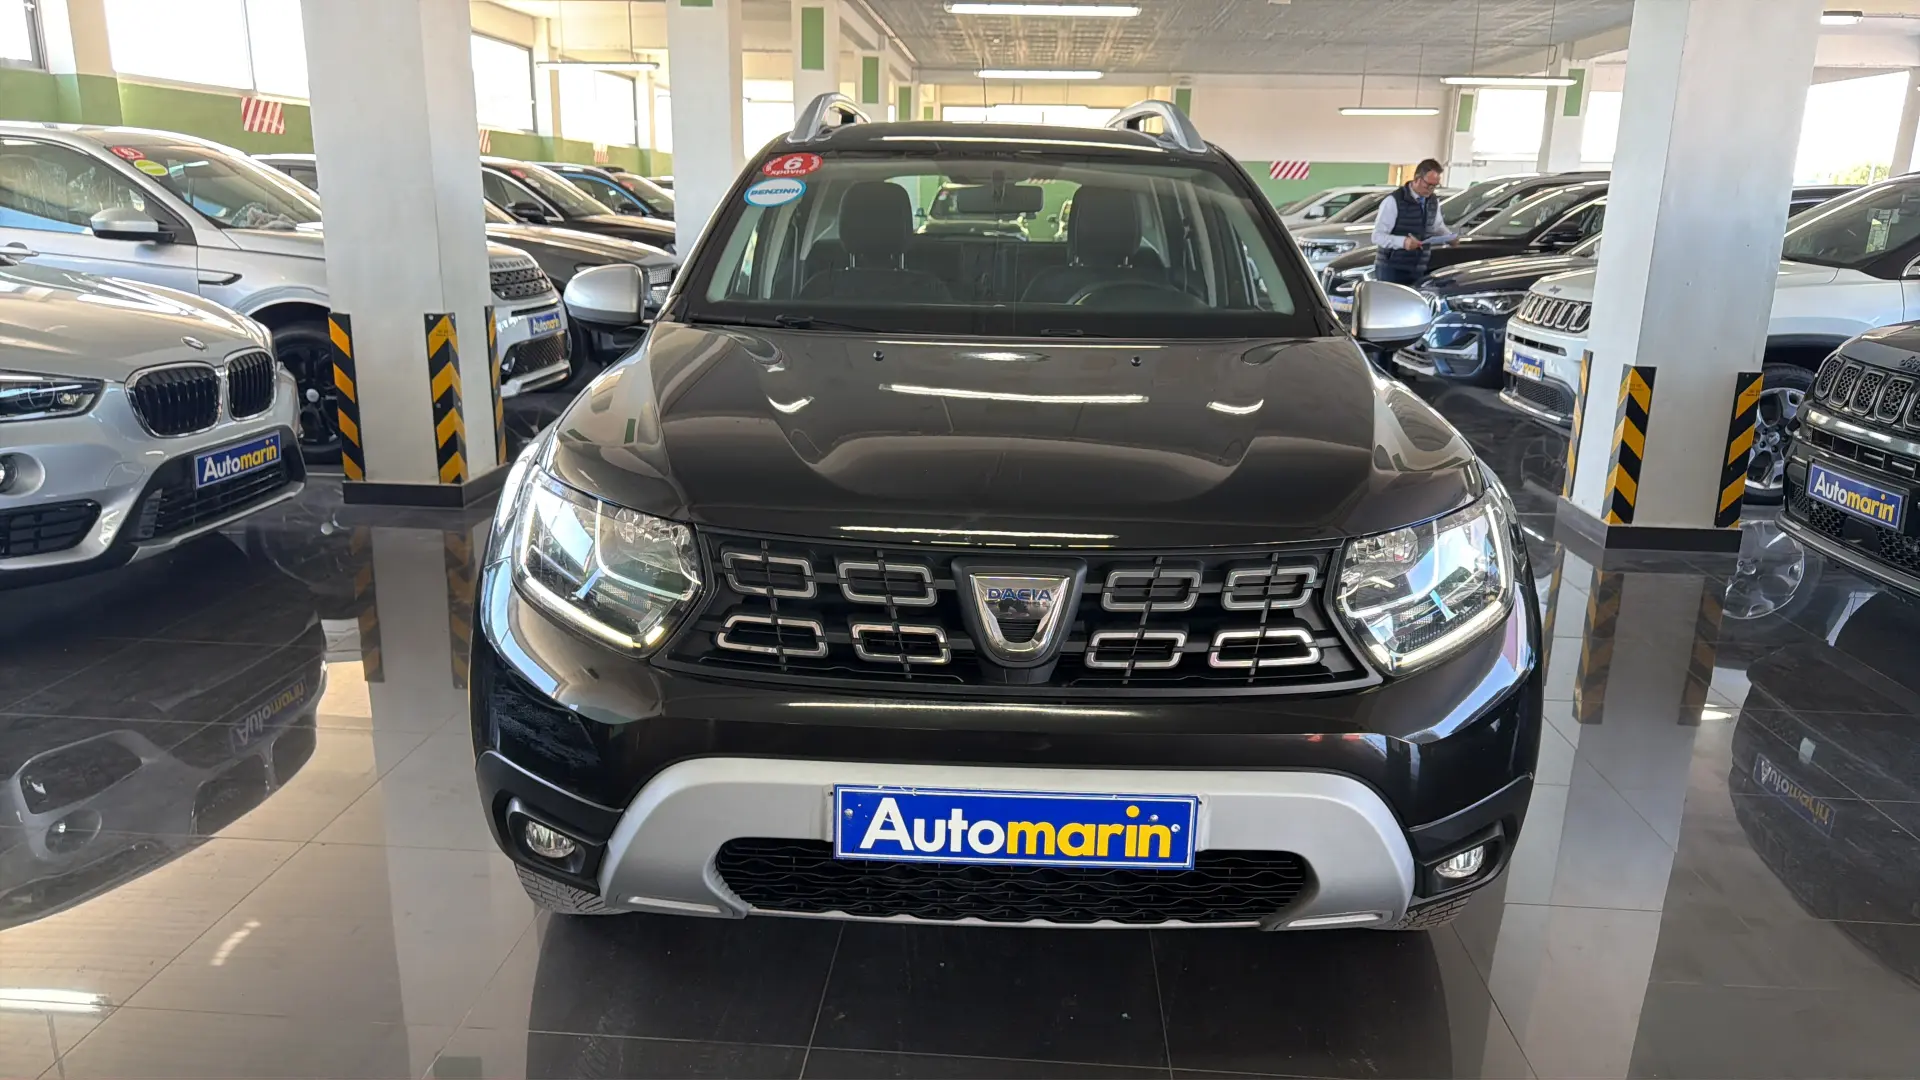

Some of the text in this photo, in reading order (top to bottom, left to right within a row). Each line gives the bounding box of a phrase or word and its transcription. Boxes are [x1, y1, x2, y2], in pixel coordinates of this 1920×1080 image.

[784, 156, 803, 170] 6
[203, 439, 277, 482] Automarin
[1813, 471, 1895, 522] Automarin
[986, 587, 1052, 601] DACIA
[859, 797, 1171, 858] Automarin
